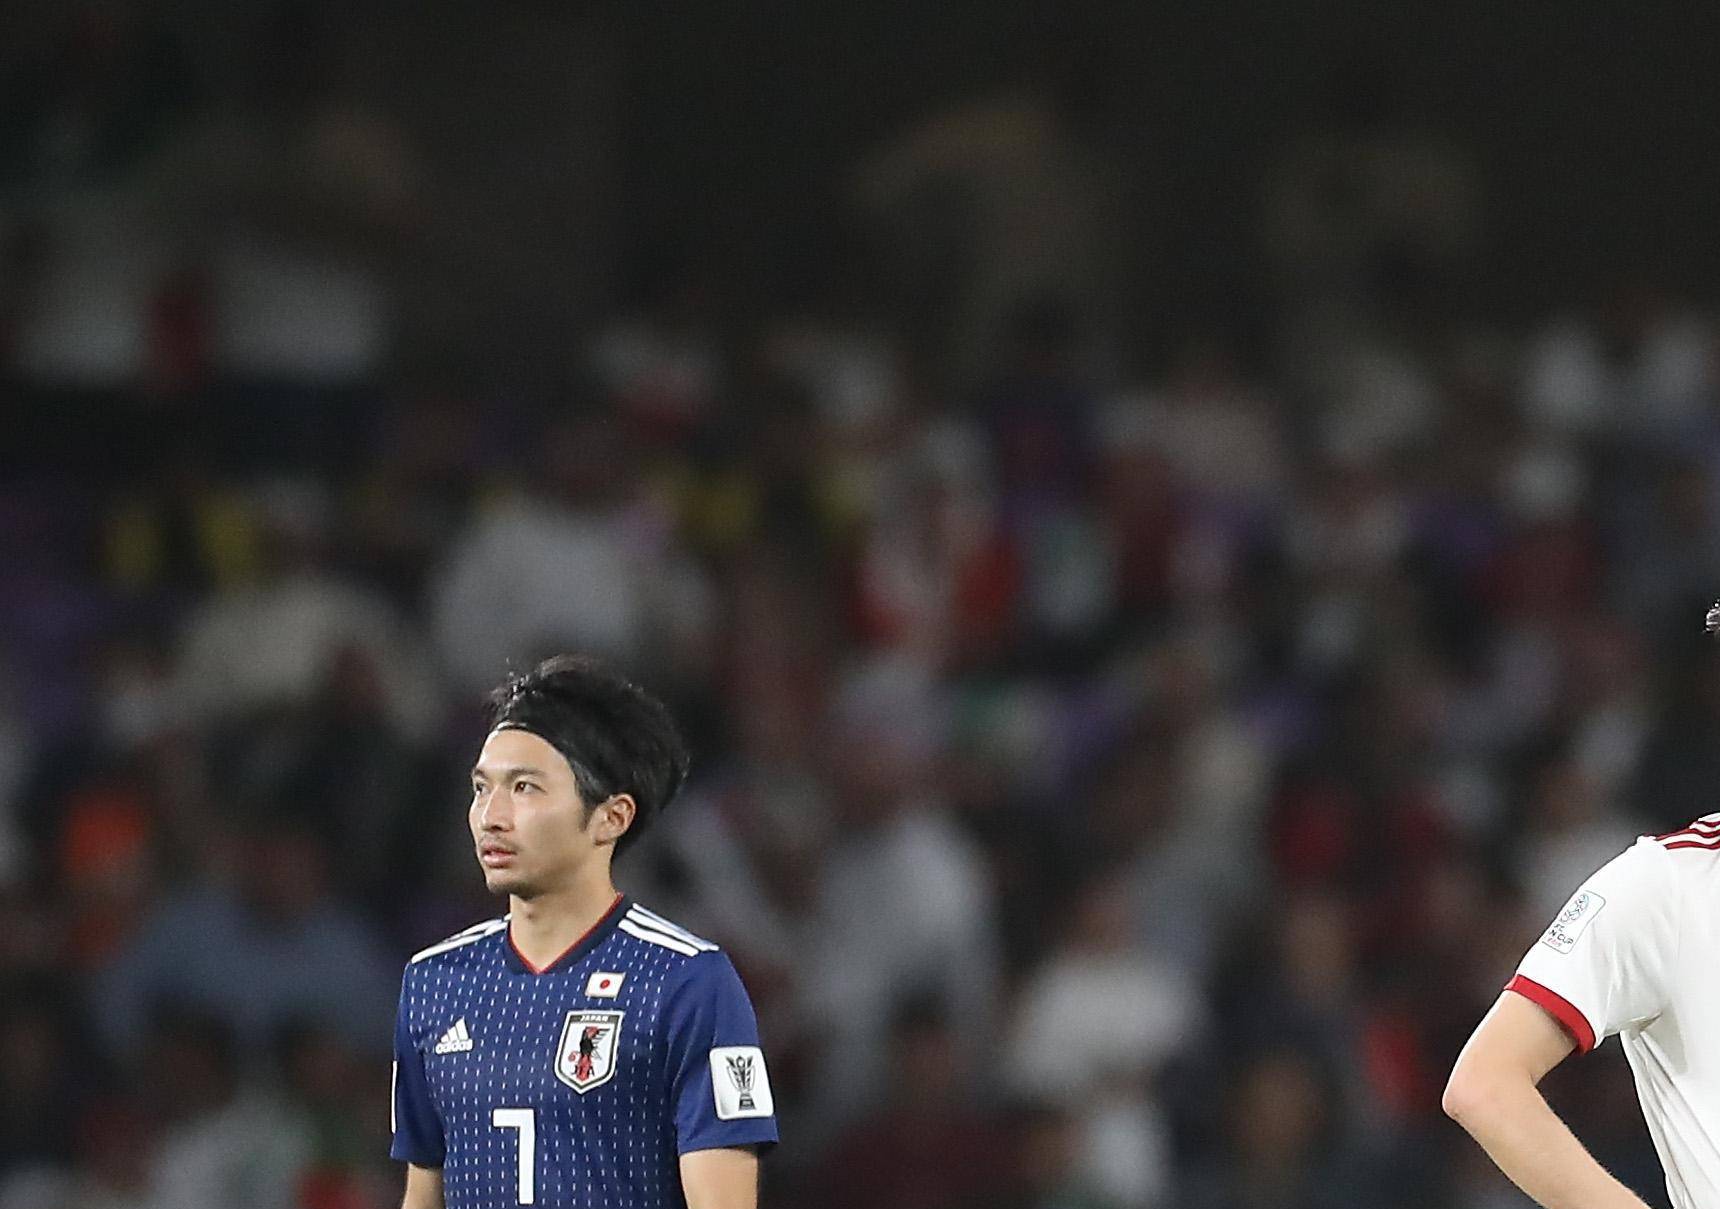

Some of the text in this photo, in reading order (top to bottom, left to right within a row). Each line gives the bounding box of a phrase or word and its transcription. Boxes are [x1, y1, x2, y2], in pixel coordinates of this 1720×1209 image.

[580, 1014, 609, 1022] JAPAN
[435, 1038, 473, 1055] adidas
[571, 1064, 595, 1077] JA
[492, 1107, 537, 1205] 7
